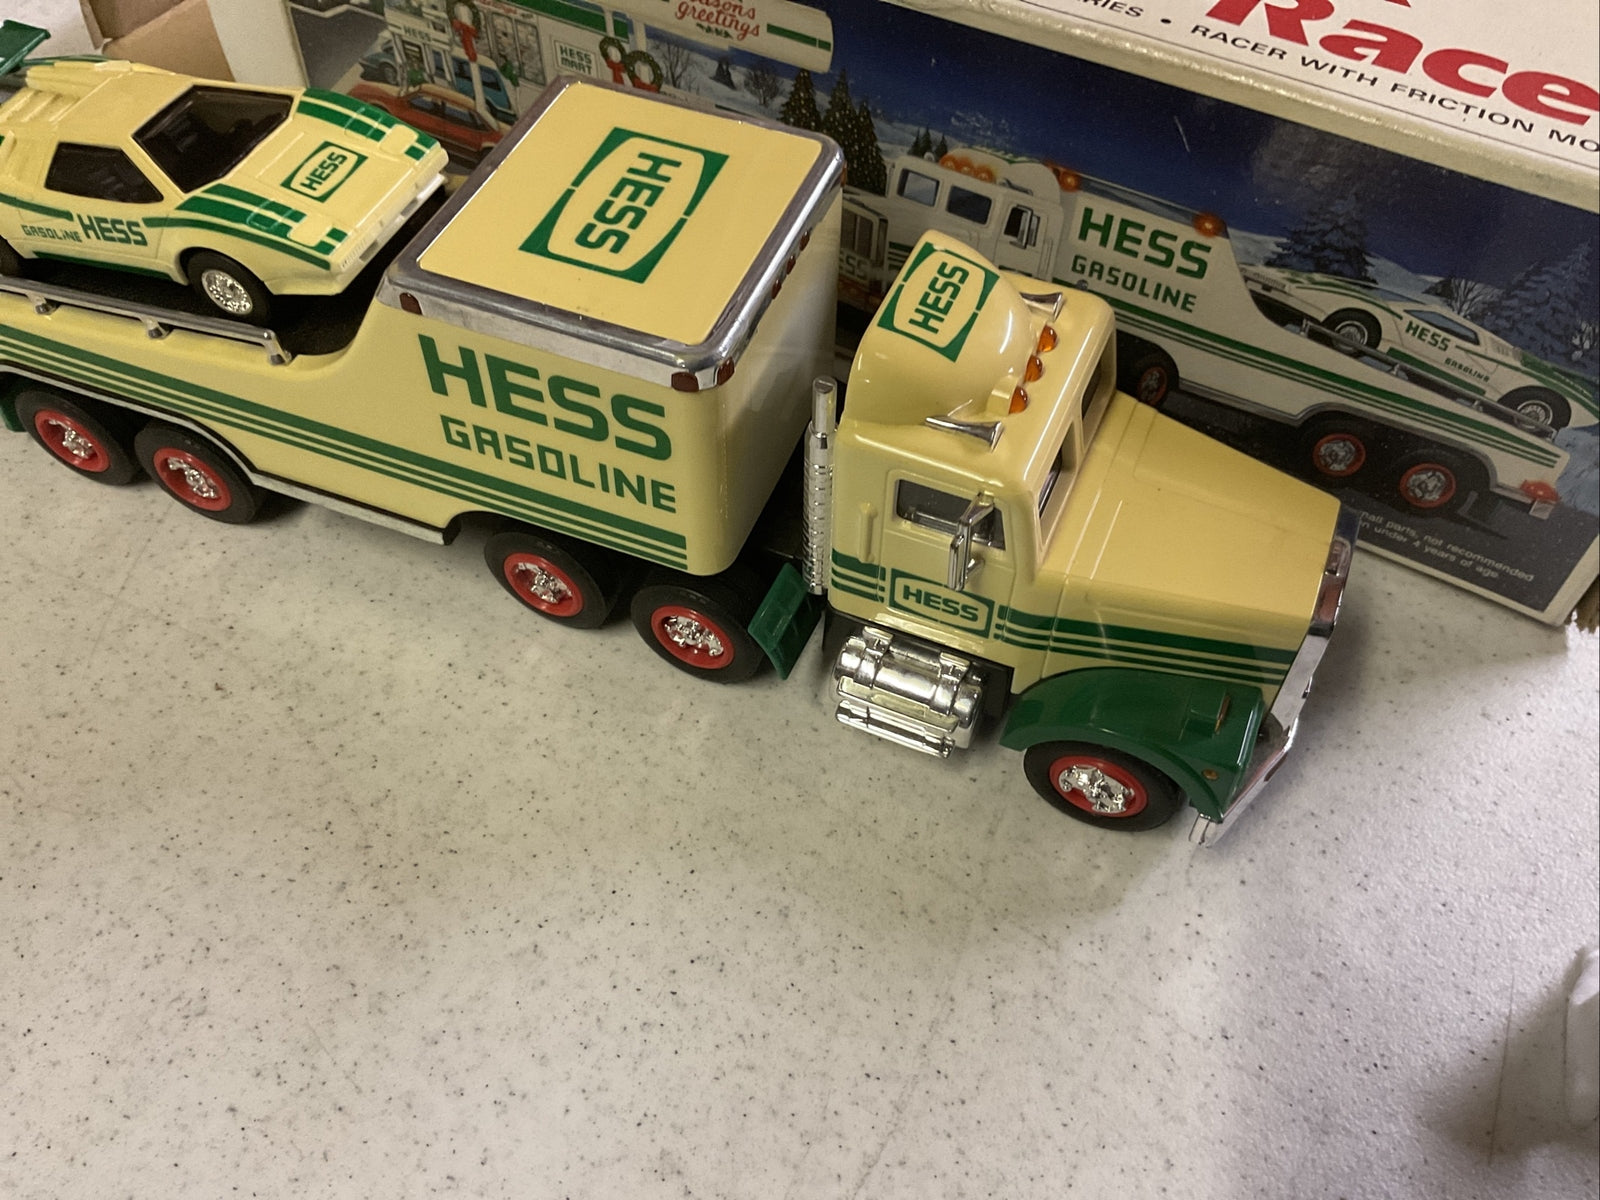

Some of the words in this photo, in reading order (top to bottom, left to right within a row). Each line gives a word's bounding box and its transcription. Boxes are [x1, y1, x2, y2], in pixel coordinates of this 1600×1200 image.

[675, 1, 760, 41] greetings
[560, 44, 592, 64] HESS
[560, 56, 592, 75] MART
[1191, 24, 1287, 60] RACER
[1301, 56, 1378, 86] WITH
[1390, 82, 1534, 133] FRICTION
[300, 151, 348, 191] HESS
[574, 152, 682, 254] HESS
[21, 224, 82, 243] GASOLINE
[76, 213, 148, 246] HESS
[1078, 206, 1212, 280] HESS
[908, 261, 970, 334] HESS
[1071, 254, 1197, 313] GASOLINE
[1405, 320, 1451, 352] HESS
[418, 333, 672, 461] HESS
[440, 414, 676, 514] GASOLINE
[1373, 526, 1408, 543] under
[1424, 545, 1456, 563] years
[1459, 558, 1473, 568] of
[1475, 564, 1499, 579] age
[1424, 533, 1444, 548] not
[1446, 543, 1535, 582] recommended
[902, 584, 979, 622] HESS
